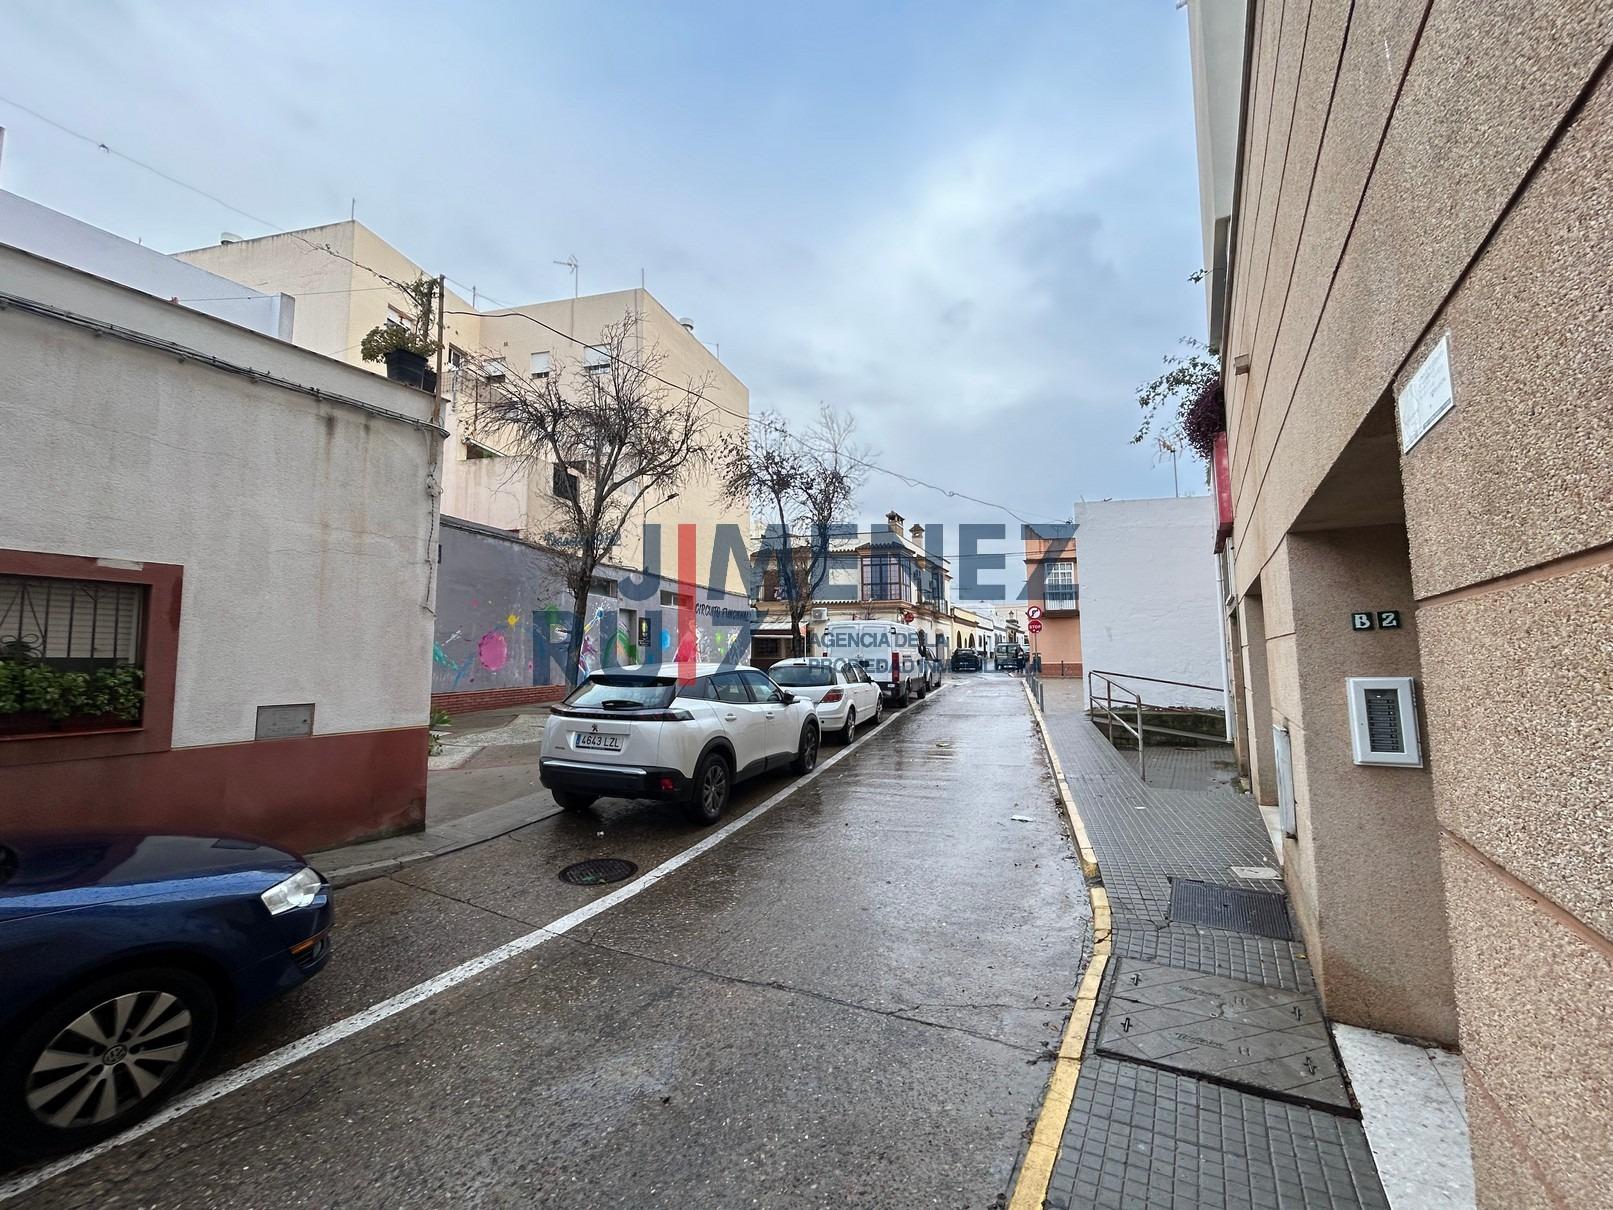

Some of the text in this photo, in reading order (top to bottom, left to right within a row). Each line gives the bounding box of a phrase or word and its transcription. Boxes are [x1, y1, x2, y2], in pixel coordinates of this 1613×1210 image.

[1354, 612, 1397, 628] B 2
[581, 736, 620, 748] 4643 LZL
